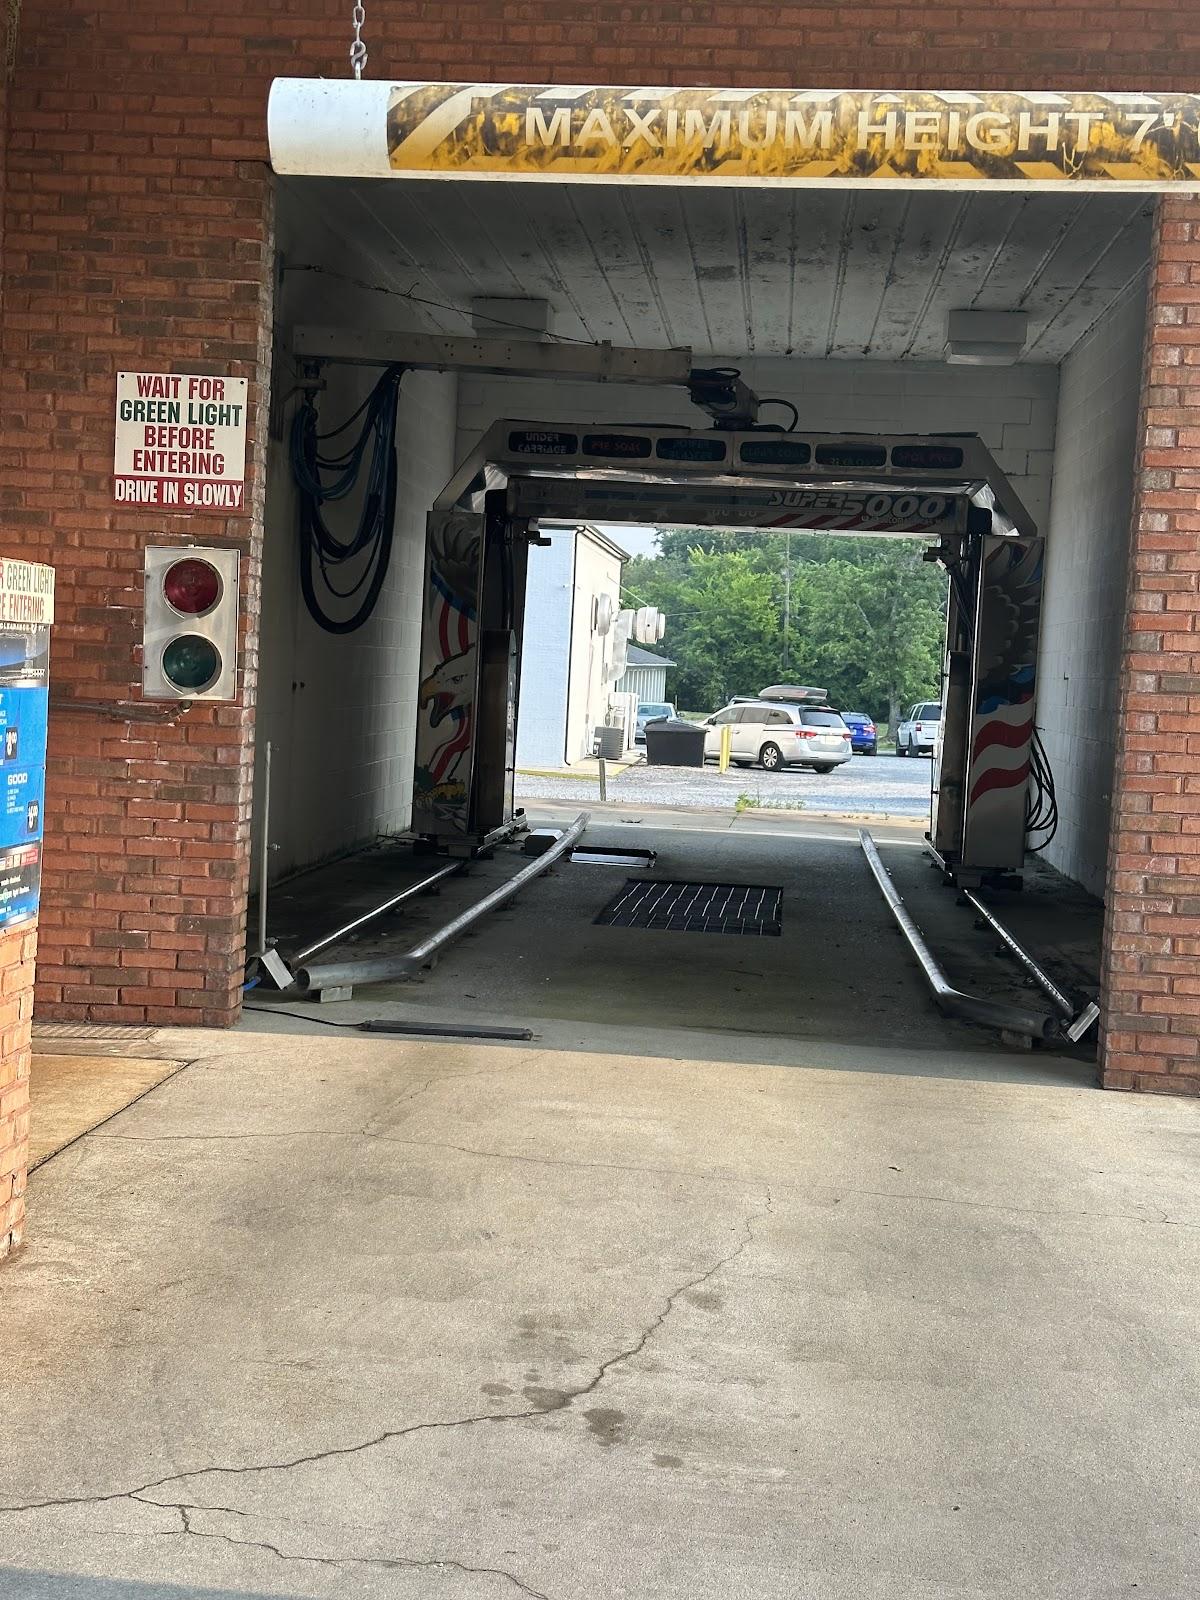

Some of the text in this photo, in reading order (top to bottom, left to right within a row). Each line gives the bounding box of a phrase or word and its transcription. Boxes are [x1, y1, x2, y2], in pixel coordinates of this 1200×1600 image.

[525, 106, 833, 150] MAXIMUM
[857, 111, 1105, 153] HEIGHT
[1125, 112, 1175, 152] 7'
[136, 375, 225, 401] WAIT FOR
[120, 400, 243, 426] GREEN LIGHT
[144, 425, 215, 450] BEFORE
[526, 432, 560, 441] UNDER
[133, 449, 225, 475] ENTERING
[114, 479, 243, 507] DRIVE IN SLOWLY
[7, 563, 31, 592] GREEN
[34, 567, 53, 595] LIGHT
[9, 593, 45, 622] ENTERING
[7, 772, 28, 785] GOOD
